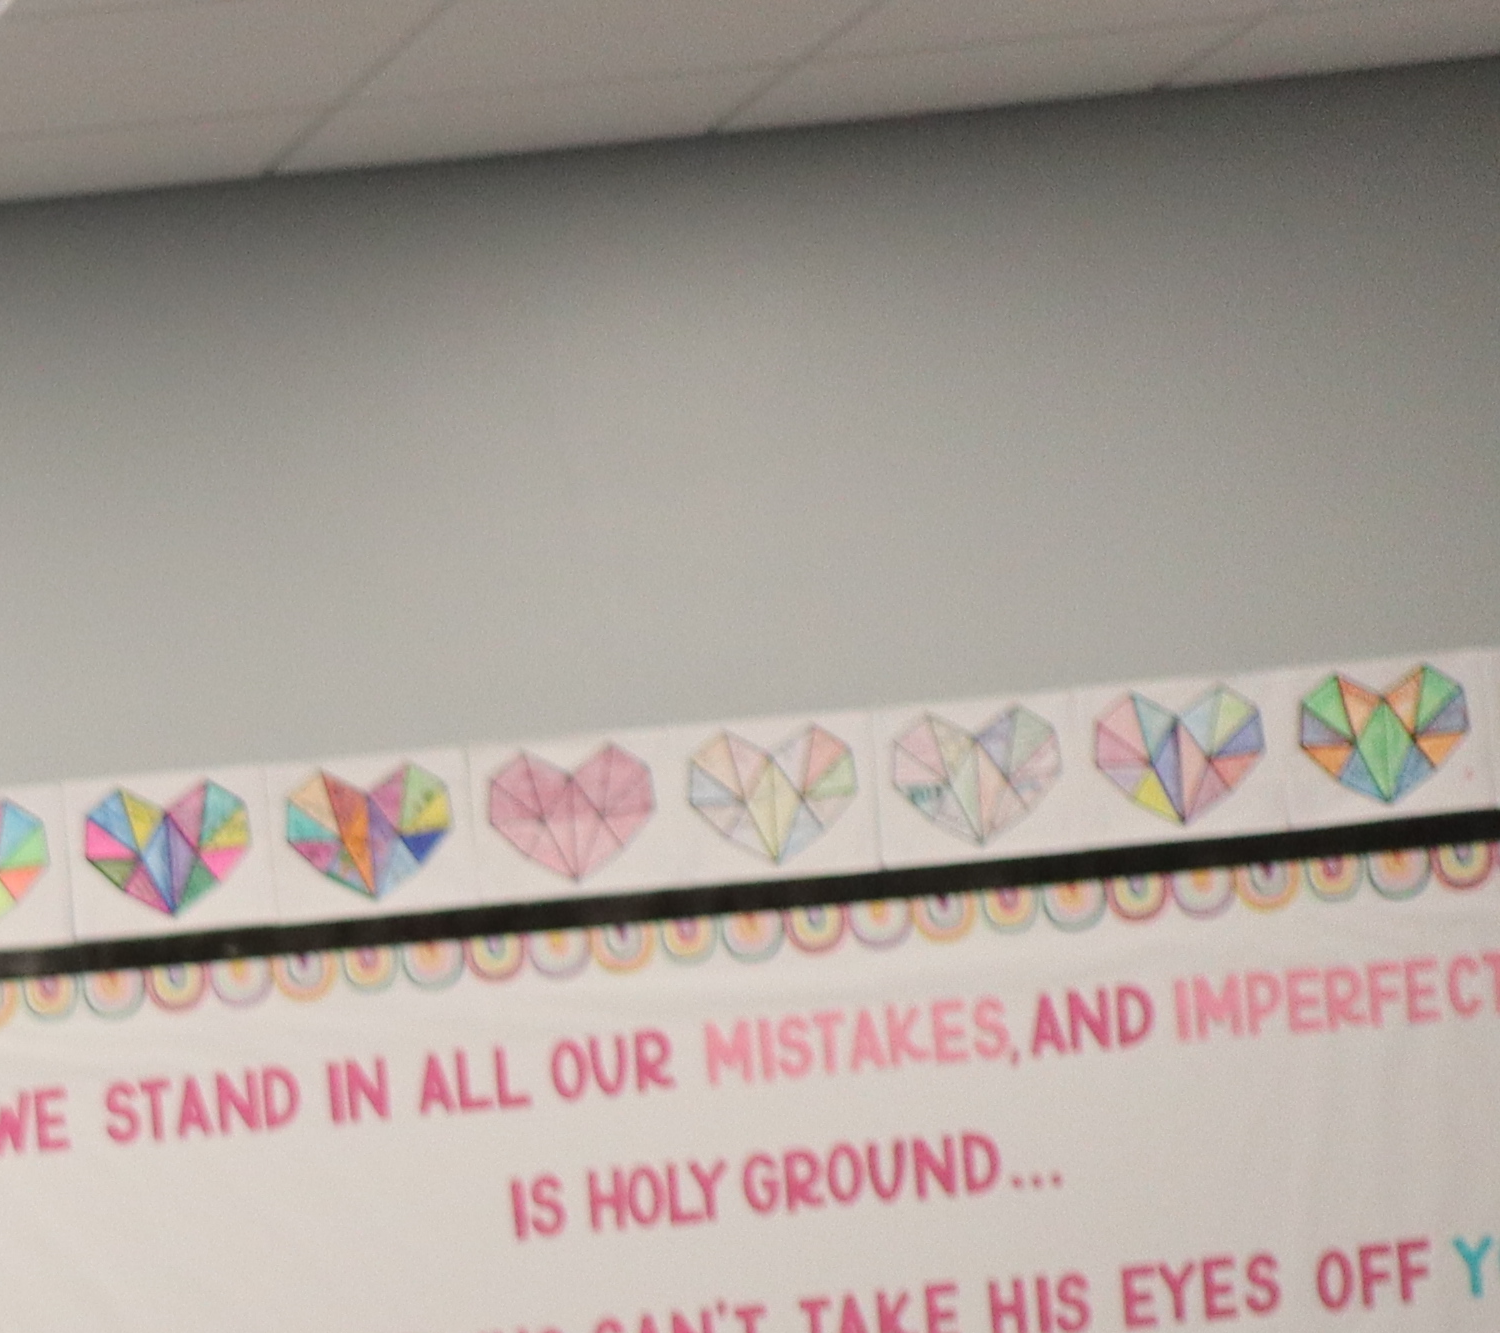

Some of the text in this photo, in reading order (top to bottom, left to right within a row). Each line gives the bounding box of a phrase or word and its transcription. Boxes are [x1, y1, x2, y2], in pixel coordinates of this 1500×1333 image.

[104, 1066, 301, 1145] STAND
[326, 1057, 390, 1125] IN
[419, 1047, 531, 1114] ALL
[550, 1028, 675, 1099] OUR
[1030, 984, 1156, 1056] AND
[510, 1131, 1064, 1240] IS HOLY GROUND...
[1120, 1252, 1282, 1331] EYES
[1316, 1238, 1432, 1313] OFF
[1453, 1235, 1500, 1298] Y
